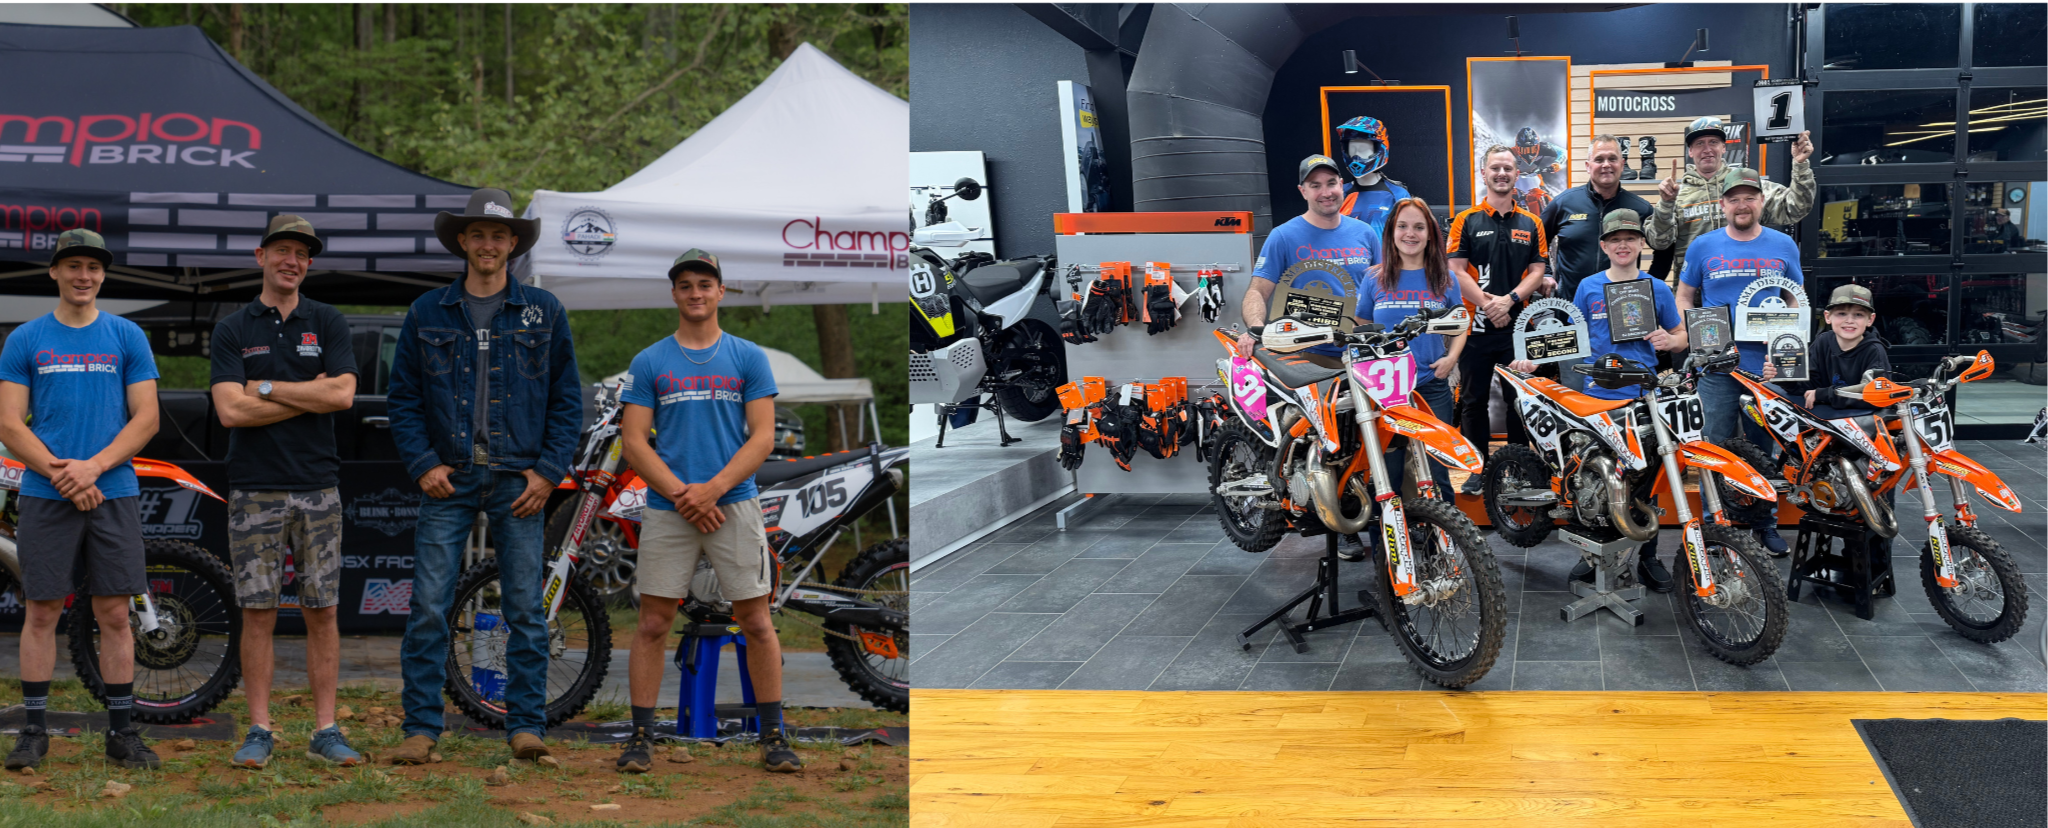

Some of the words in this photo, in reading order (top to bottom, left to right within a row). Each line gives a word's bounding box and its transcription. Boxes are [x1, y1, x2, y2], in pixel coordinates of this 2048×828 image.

[1598, 96, 1676, 112] MOTOCROSS
[1766, 92, 1792, 130] 1
[89, 144, 257, 169] BRICK
[1214, 216, 1241, 226] KTM
[1296, 243, 1369, 266] Champion
[1707, 254, 1784, 277] Champion
[1303, 261, 1354, 285] DISTRICT
[1740, 287, 1756, 306] AMA
[1756, 277, 1803, 296] DISTRICT
[1515, 312, 1530, 331] AMA
[1530, 299, 1578, 314] DISTRICT
[302, 333, 317, 345] ZM
[1547, 348, 1578, 356] SECOND
[36, 348, 118, 372] Champion
[88, 363, 117, 374] BRICK
[1234, 374, 1267, 407] 31
[1368, 357, 1409, 400] 31
[1524, 404, 1556, 437] 118
[1665, 398, 1704, 435] 118
[1765, 407, 1797, 433] 51
[1924, 410, 1951, 448] 51
[796, 477, 847, 519] 105
[359, 507, 389, 518] BLINK
[1386, 524, 1399, 564] Klim
[1687, 542, 1700, 572] Klim
[1931, 536, 1944, 567] Klim
